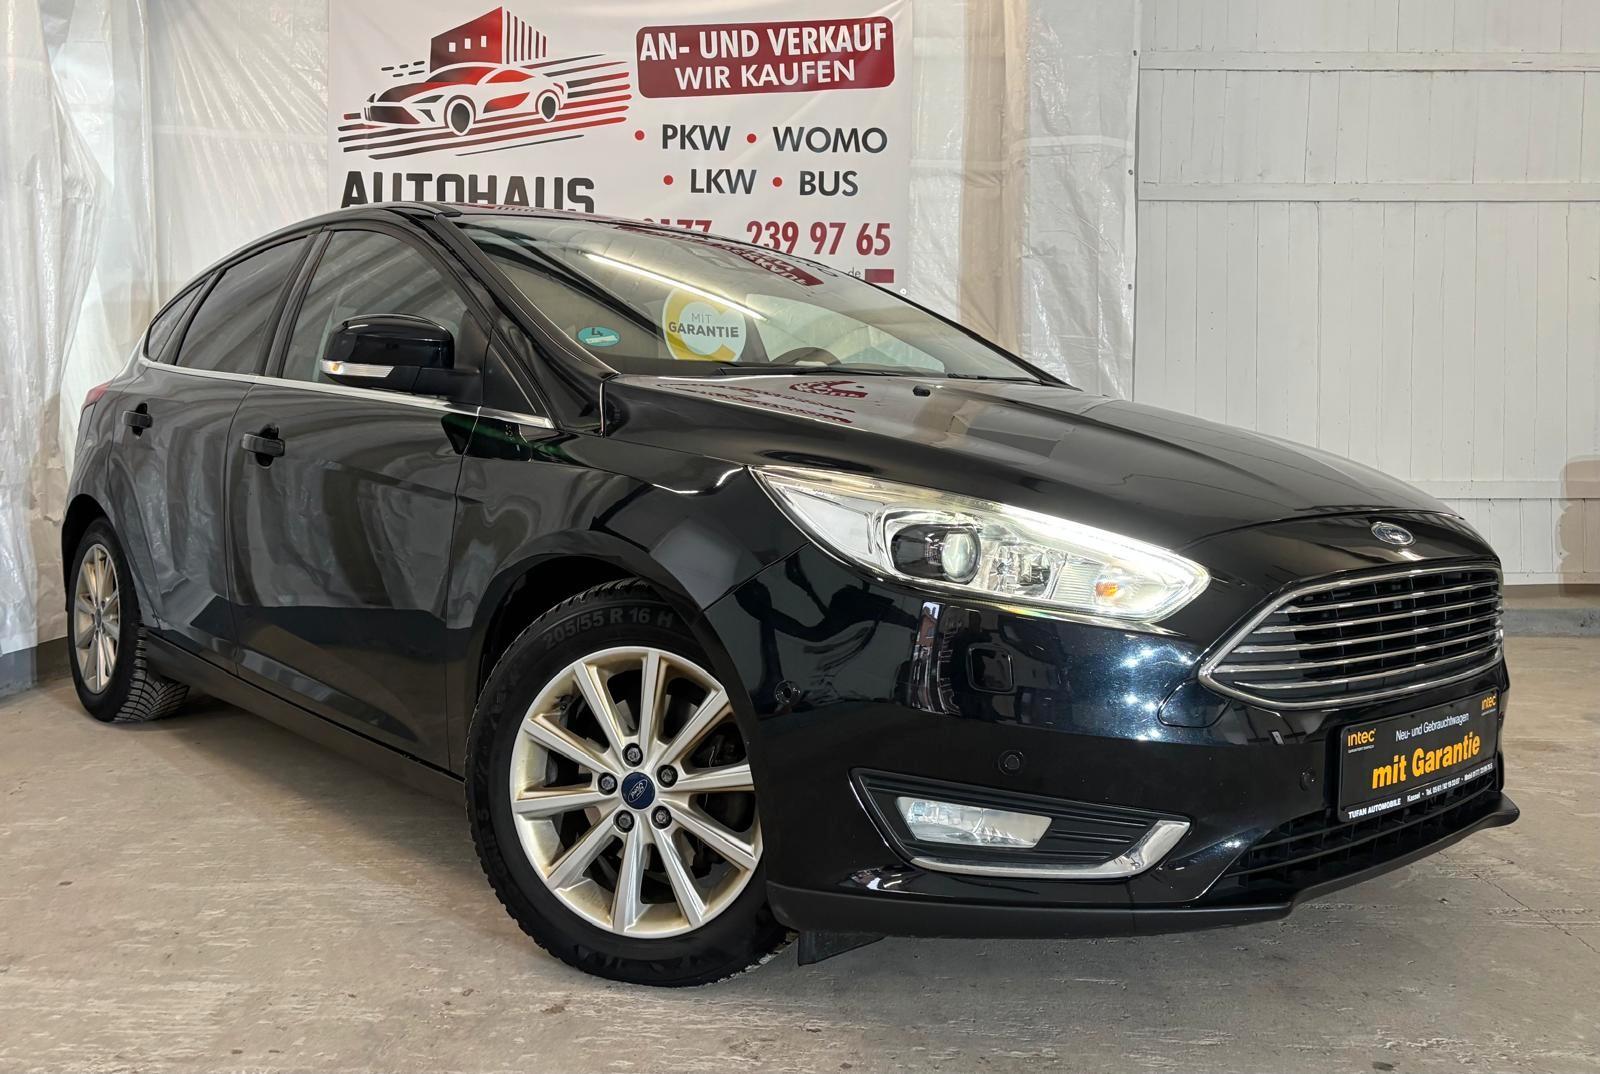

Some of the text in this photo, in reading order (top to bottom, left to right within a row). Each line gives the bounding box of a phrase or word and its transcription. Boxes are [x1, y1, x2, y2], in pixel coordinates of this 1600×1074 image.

[640, 22, 887, 61] AN- UND VERKAUF
[674, 59, 855, 90] WIR KAUFEN
[662, 124, 888, 153] PKW WOMO
[340, 170, 594, 213] AUTOHAUS
[691, 169, 858, 197] LKW BUS
[746, 220, 799, 254] 239
[810, 221, 846, 255] 97
[856, 222, 891, 256] 65
[668, 321, 739, 338] GARANTIE
[691, 313, 712, 323] MIT
[543, 610, 604, 650] 205/55
[610, 607, 623, 623] R
[629, 607, 651, 623] 16
[1411, 723, 1423, 736] und
[1423, 712, 1470, 733] Gebrauchtwagen
[1372, 754, 1407, 789] mit
[1412, 731, 1481, 777] Garantie
[1368, 798, 1401, 814] AUTOMOBILE
